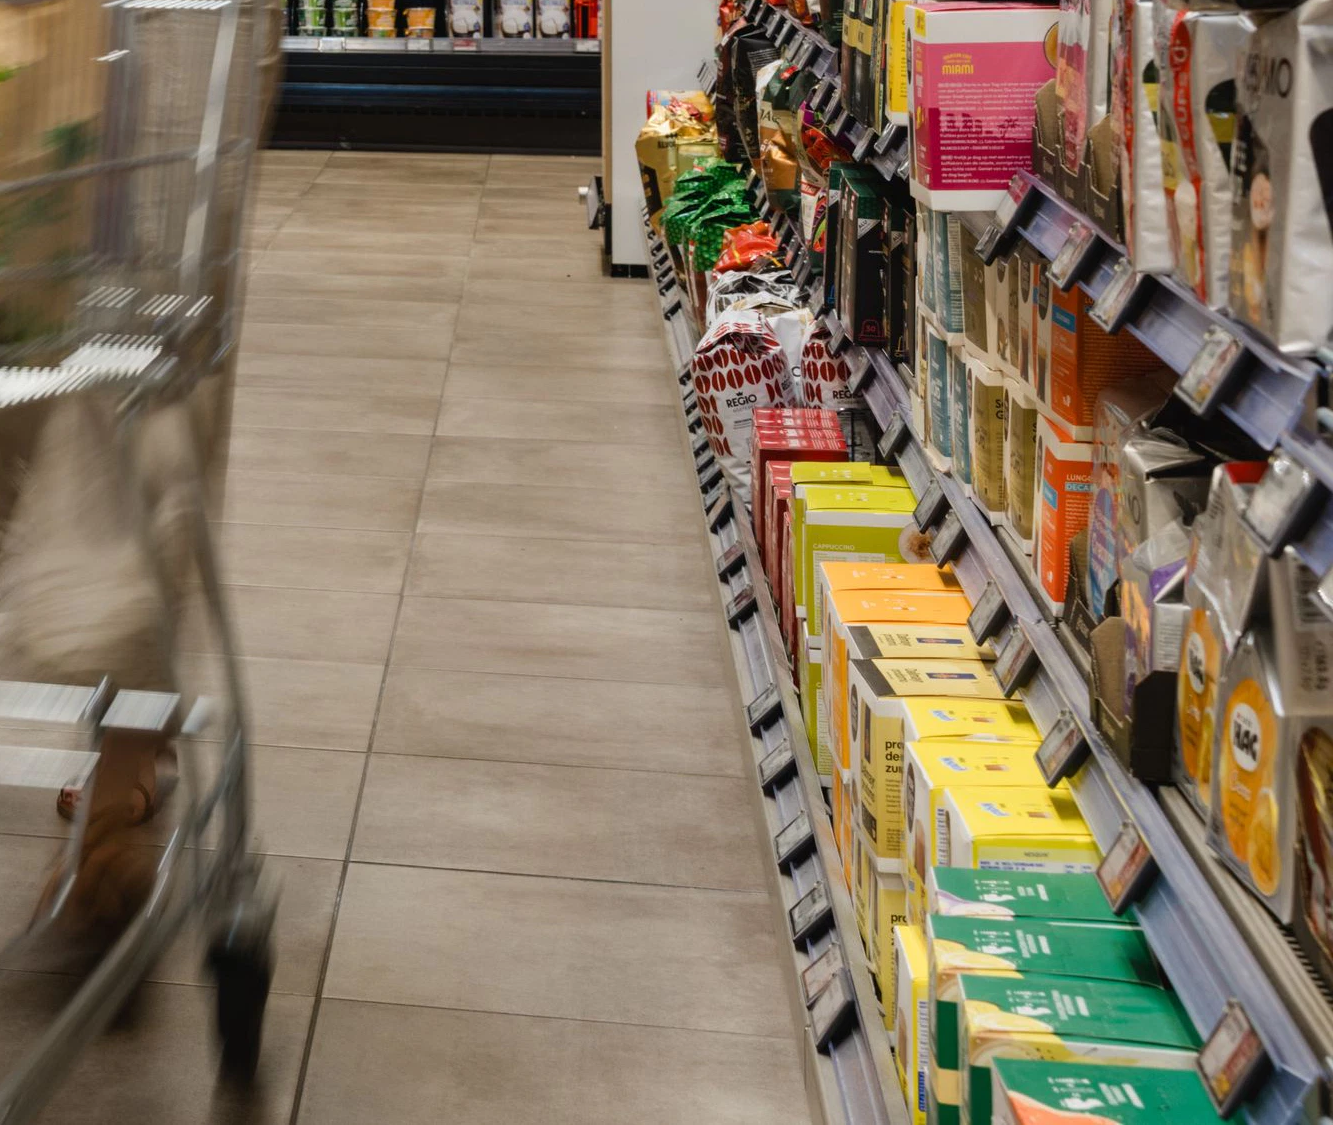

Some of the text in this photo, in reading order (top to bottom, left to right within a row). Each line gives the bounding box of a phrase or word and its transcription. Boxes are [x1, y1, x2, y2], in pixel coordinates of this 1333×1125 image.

[942, 64, 974, 75] MIAMI
[726, 393, 758, 409] REGIO
[813, 543, 855, 551] CAPPUCCINO
